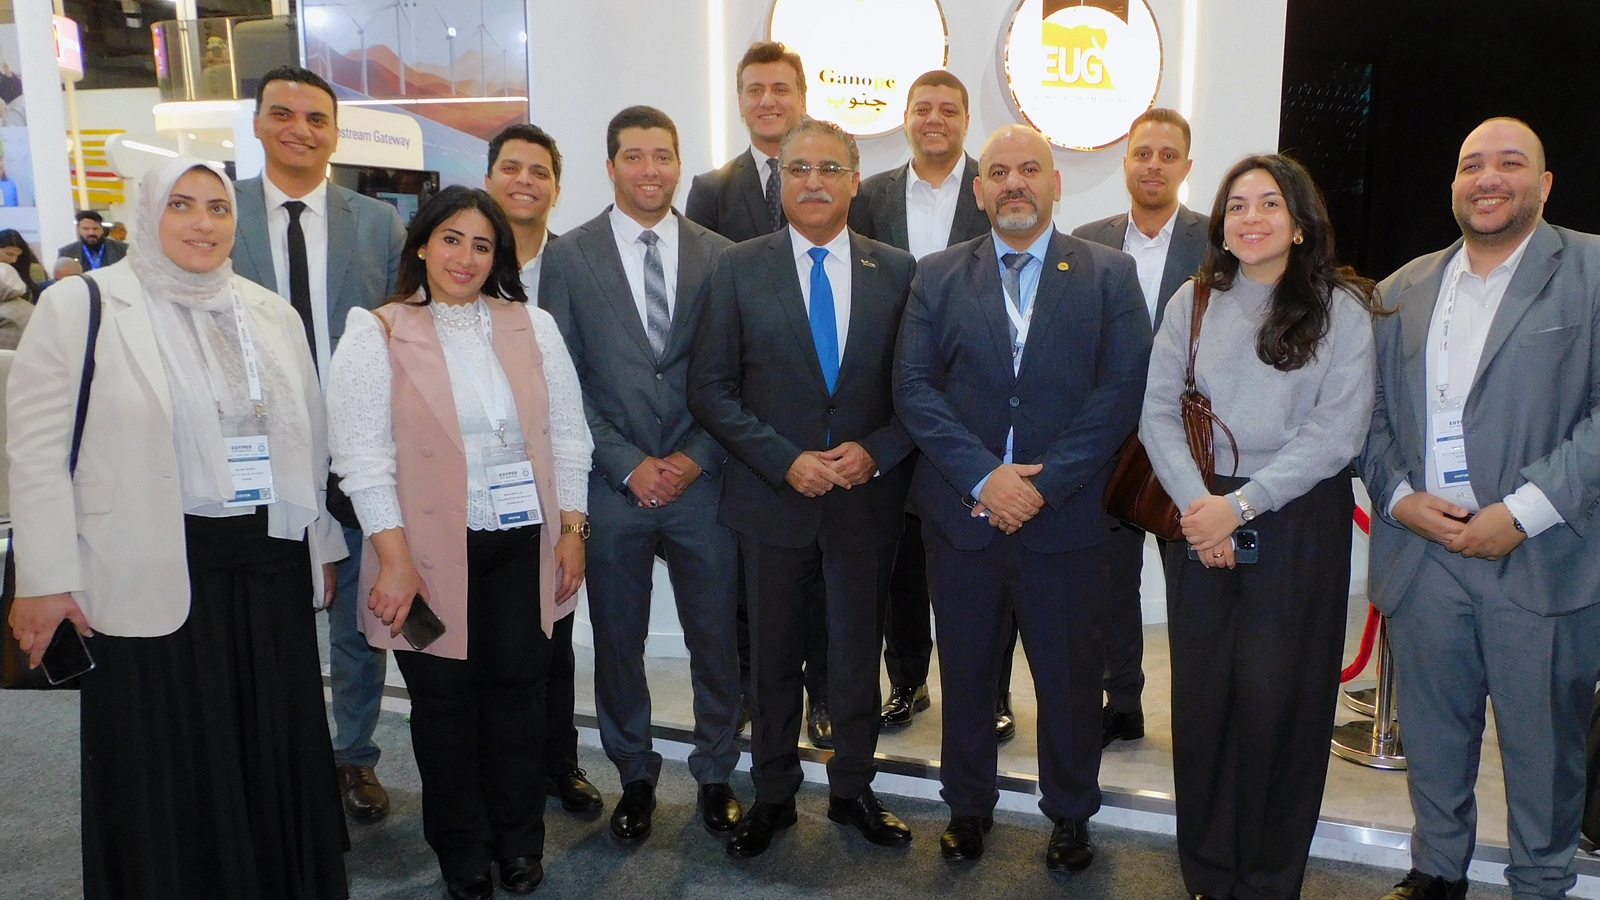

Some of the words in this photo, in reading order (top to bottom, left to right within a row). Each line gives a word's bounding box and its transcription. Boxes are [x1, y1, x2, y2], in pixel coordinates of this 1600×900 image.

[819, 69, 895, 91] Ganope
[827, 93, 887, 112] جنوب
[374, 130, 410, 149] Gateway
